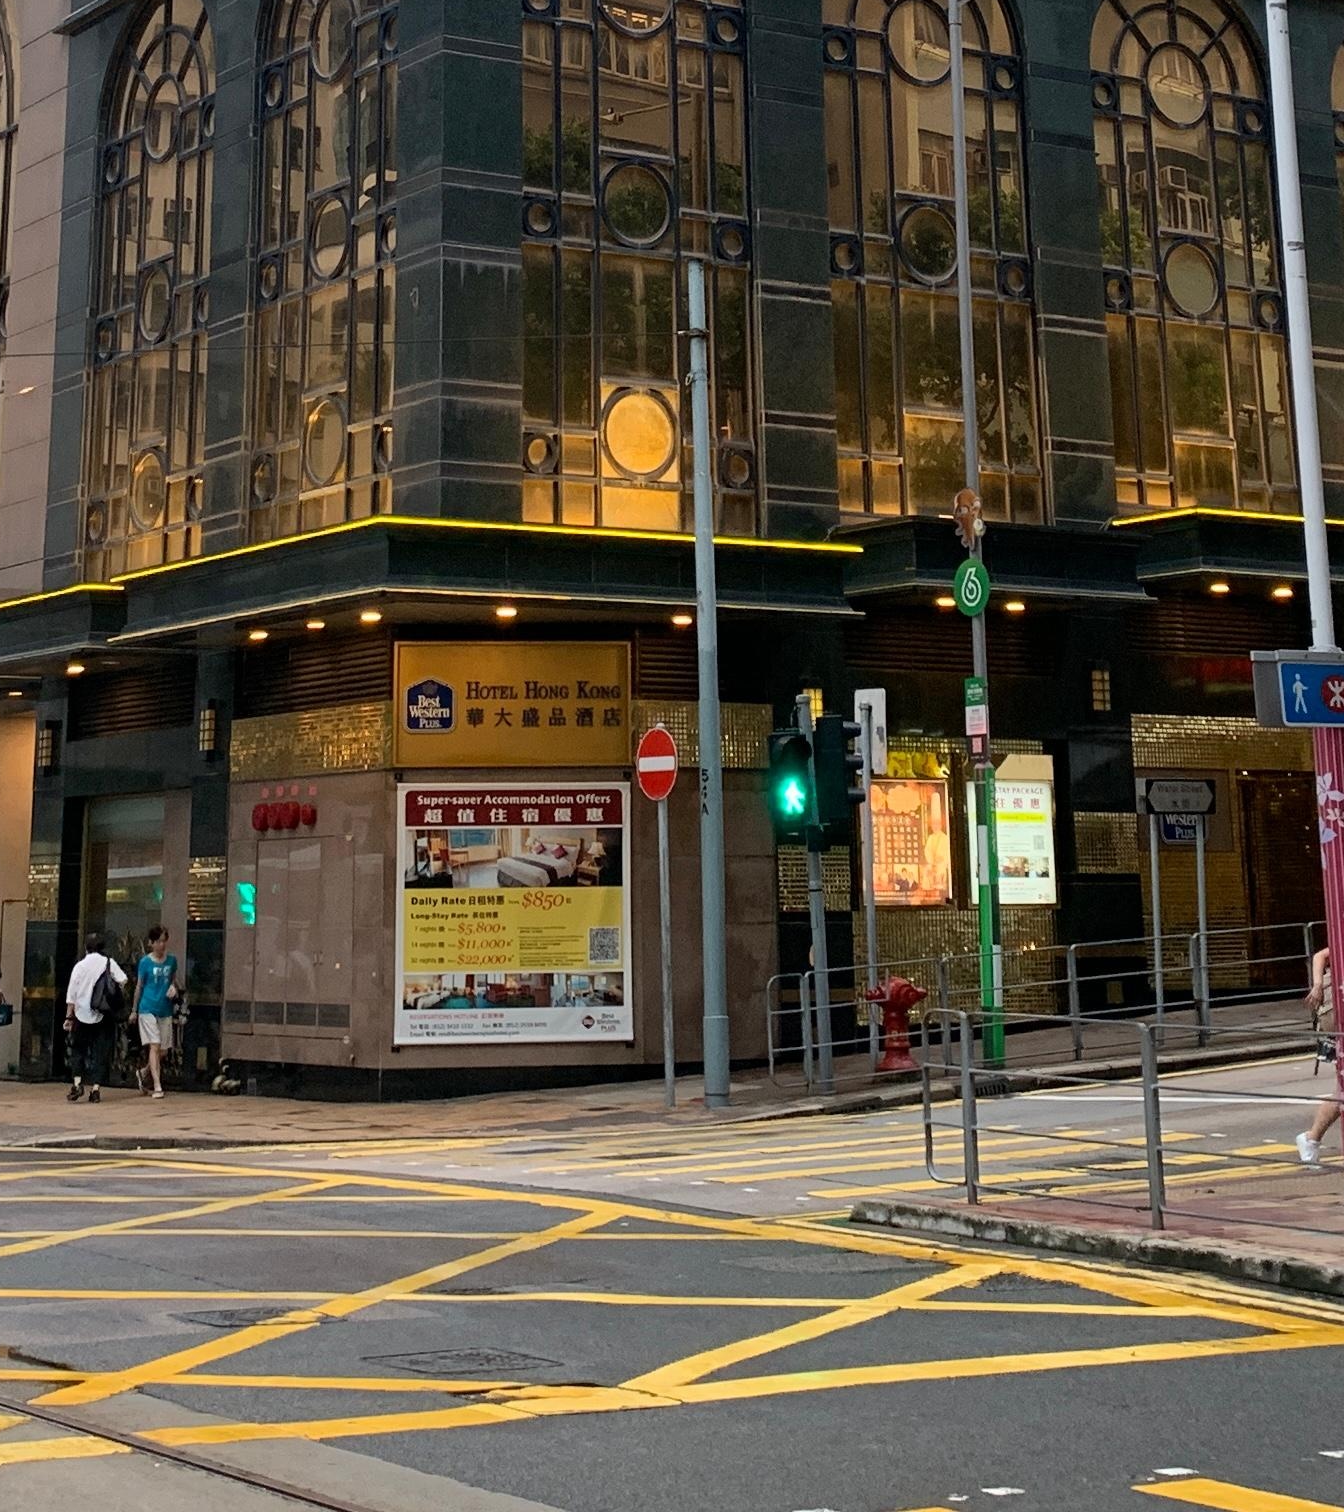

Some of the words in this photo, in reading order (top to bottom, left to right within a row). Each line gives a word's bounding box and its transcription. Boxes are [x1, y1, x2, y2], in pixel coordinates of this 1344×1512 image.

[960, 567, 982, 607] 6
[465, 680, 518, 700] HOTEL
[523, 680, 570, 700] HONG
[576, 680, 622, 700] KONG
[417, 694, 441, 708] Best
[408, 705, 451, 719] Western
[465, 707, 623, 728] 華大盛品酒店
[417, 794, 482, 807] Super-saver
[484, 792, 574, 805] Accommodation
[575, 791, 611, 805] Offers
[424, 807, 605, 824] 超值住宿優惠
[411, 896, 438, 907] Daily
[441, 896, 466, 906] Rate
[522, 890, 565, 911] $850
[450, 912, 469, 920] Rate
